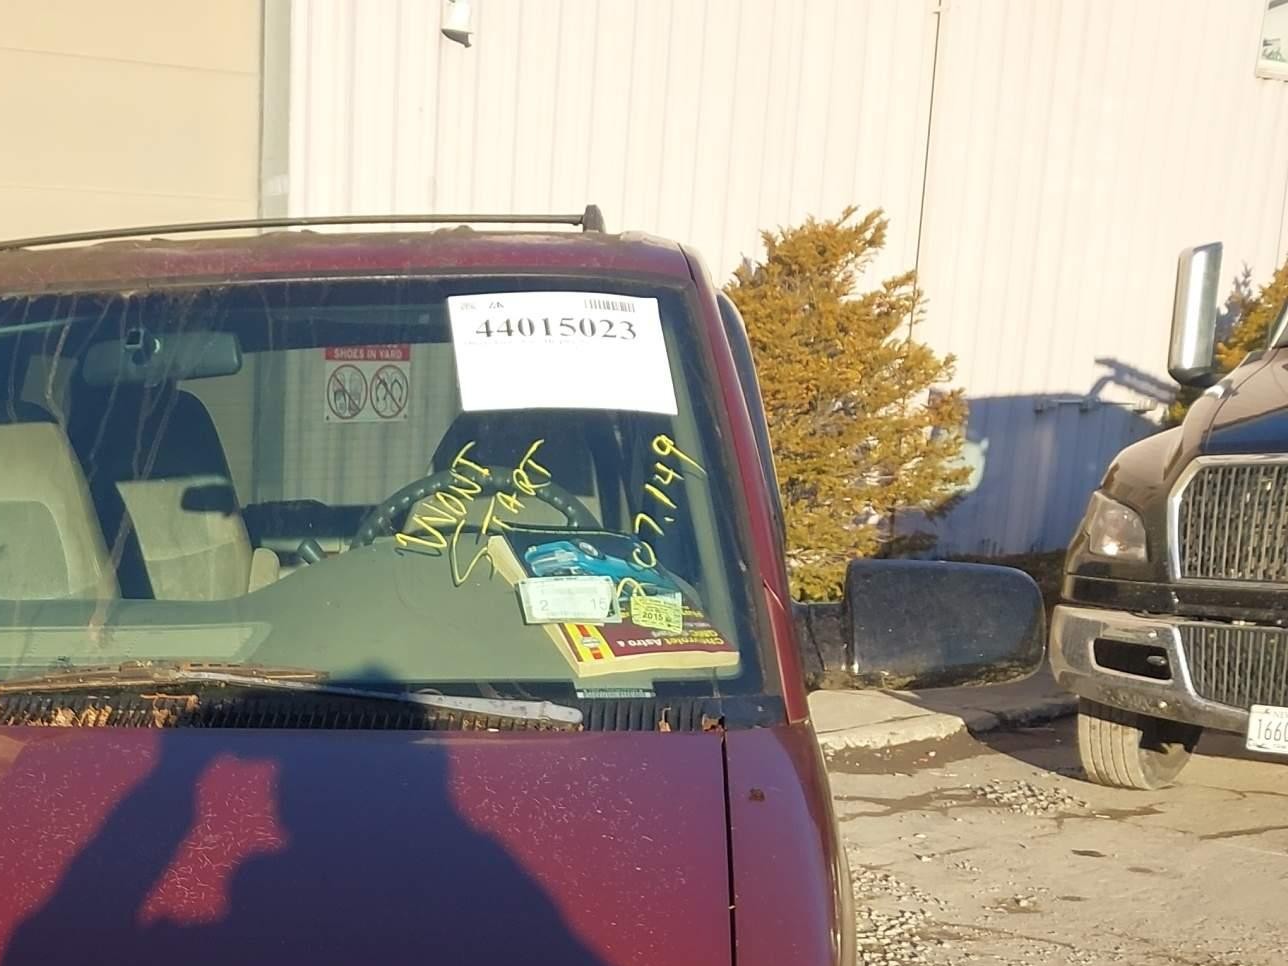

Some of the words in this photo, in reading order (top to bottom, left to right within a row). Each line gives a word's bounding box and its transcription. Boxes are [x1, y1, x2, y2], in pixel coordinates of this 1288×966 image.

[475, 317, 637, 341] 44015023
[333, 347, 365, 360] SHOES
[367, 347, 377, 360] IN
[379, 347, 402, 360] YARD
[395, 441, 489, 548] WONT
[449, 439, 551, 584] START
[642, 611, 664, 621] 2015
[628, 638, 663, 647] Astro
